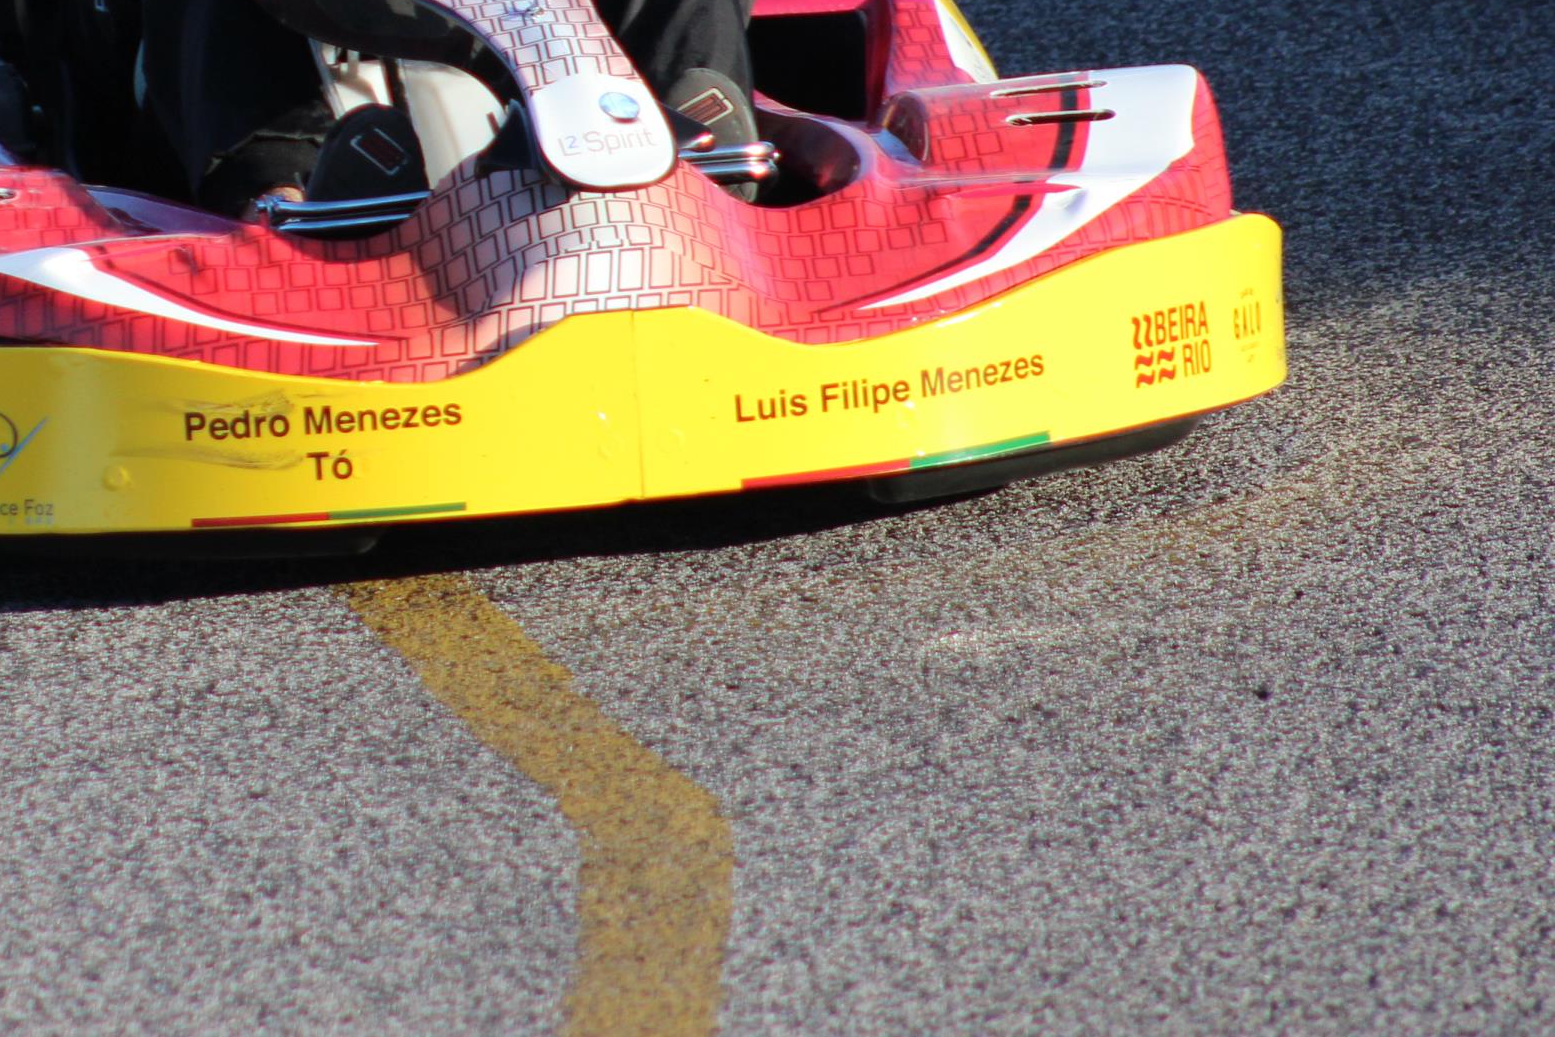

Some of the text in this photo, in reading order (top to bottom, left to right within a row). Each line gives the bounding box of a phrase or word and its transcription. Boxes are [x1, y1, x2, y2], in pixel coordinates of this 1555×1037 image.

[1154, 301, 1209, 345] BEIRA
[1183, 339, 1211, 377] RIO
[735, 354, 1045, 423] Luis Filipe Menezes
[184, 403, 462, 441] Pedro Menezes
[307, 449, 353, 480] Tó
[24, 499, 54, 515] Foz
